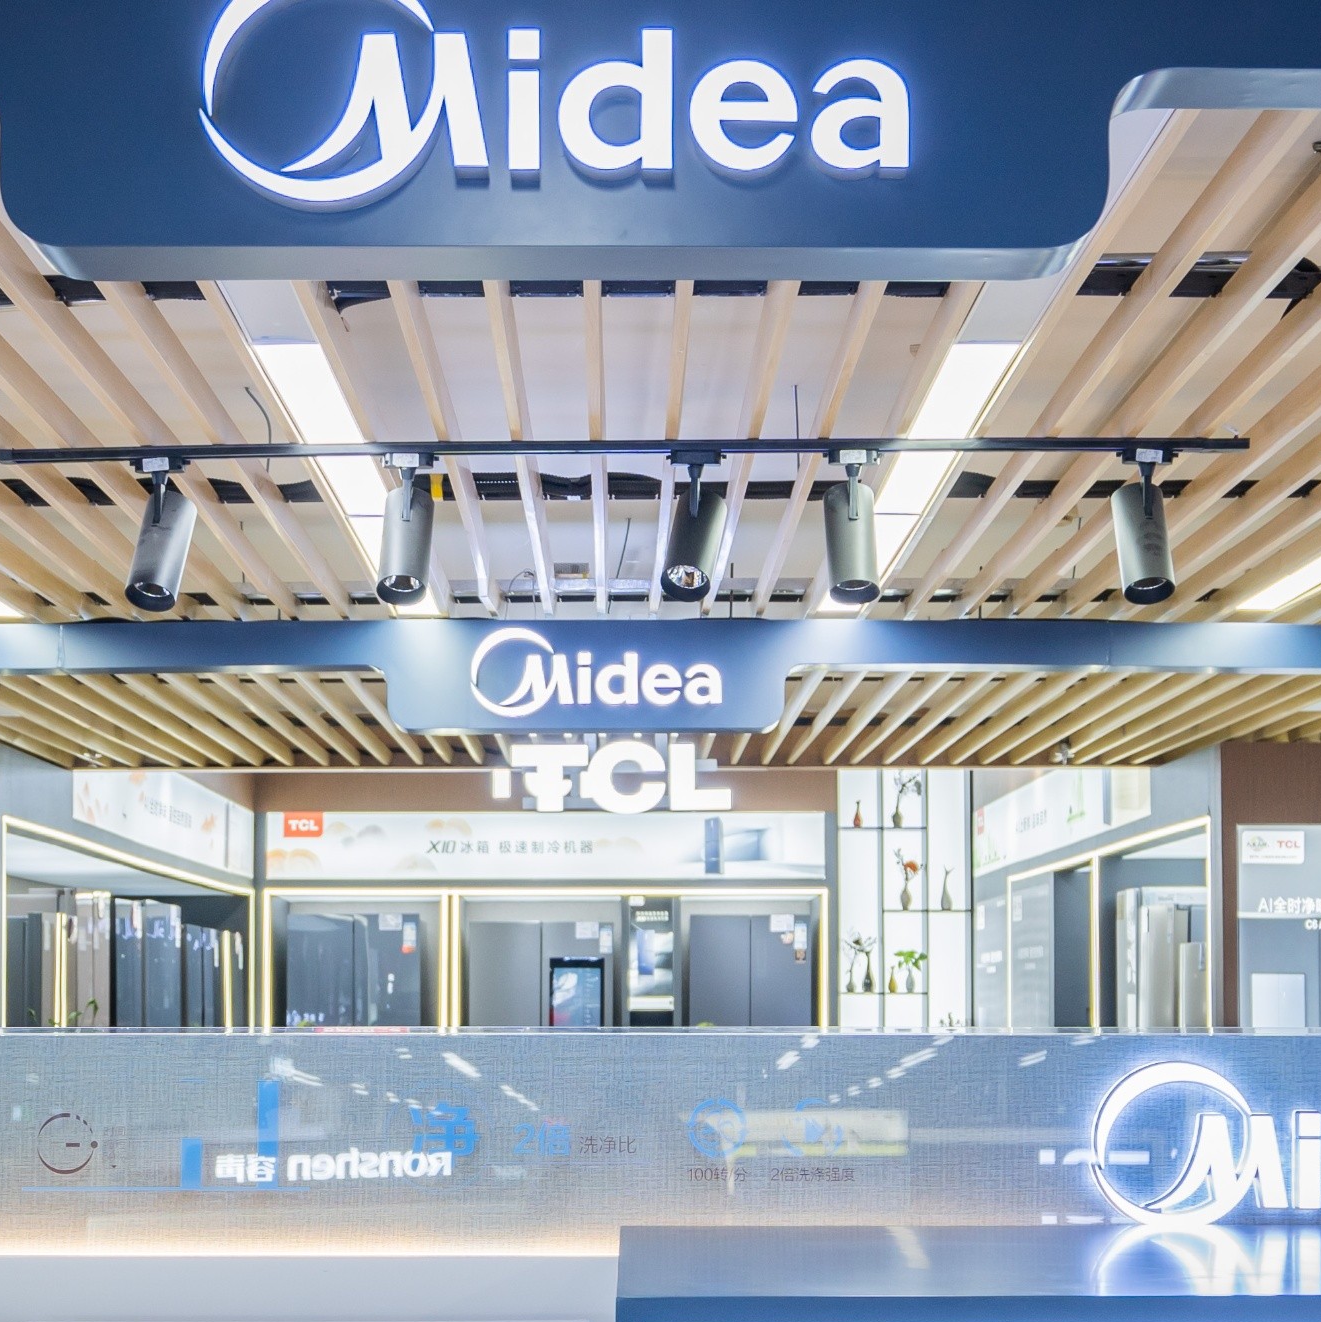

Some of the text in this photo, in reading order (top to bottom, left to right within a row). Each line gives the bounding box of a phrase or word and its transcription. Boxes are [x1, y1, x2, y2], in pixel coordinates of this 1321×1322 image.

[199, 0, 912, 205] Midea
[470, 627, 723, 717] Midea
[510, 740, 732, 814] TCL
[288, 819, 319, 832] TCL
[460, 839, 490, 855] 冰箱
[499, 839, 594, 855] 极速制冷机器
[1277, 840, 1301, 849] TCL
[514, 1119, 638, 1156] 2倍 洗净比
